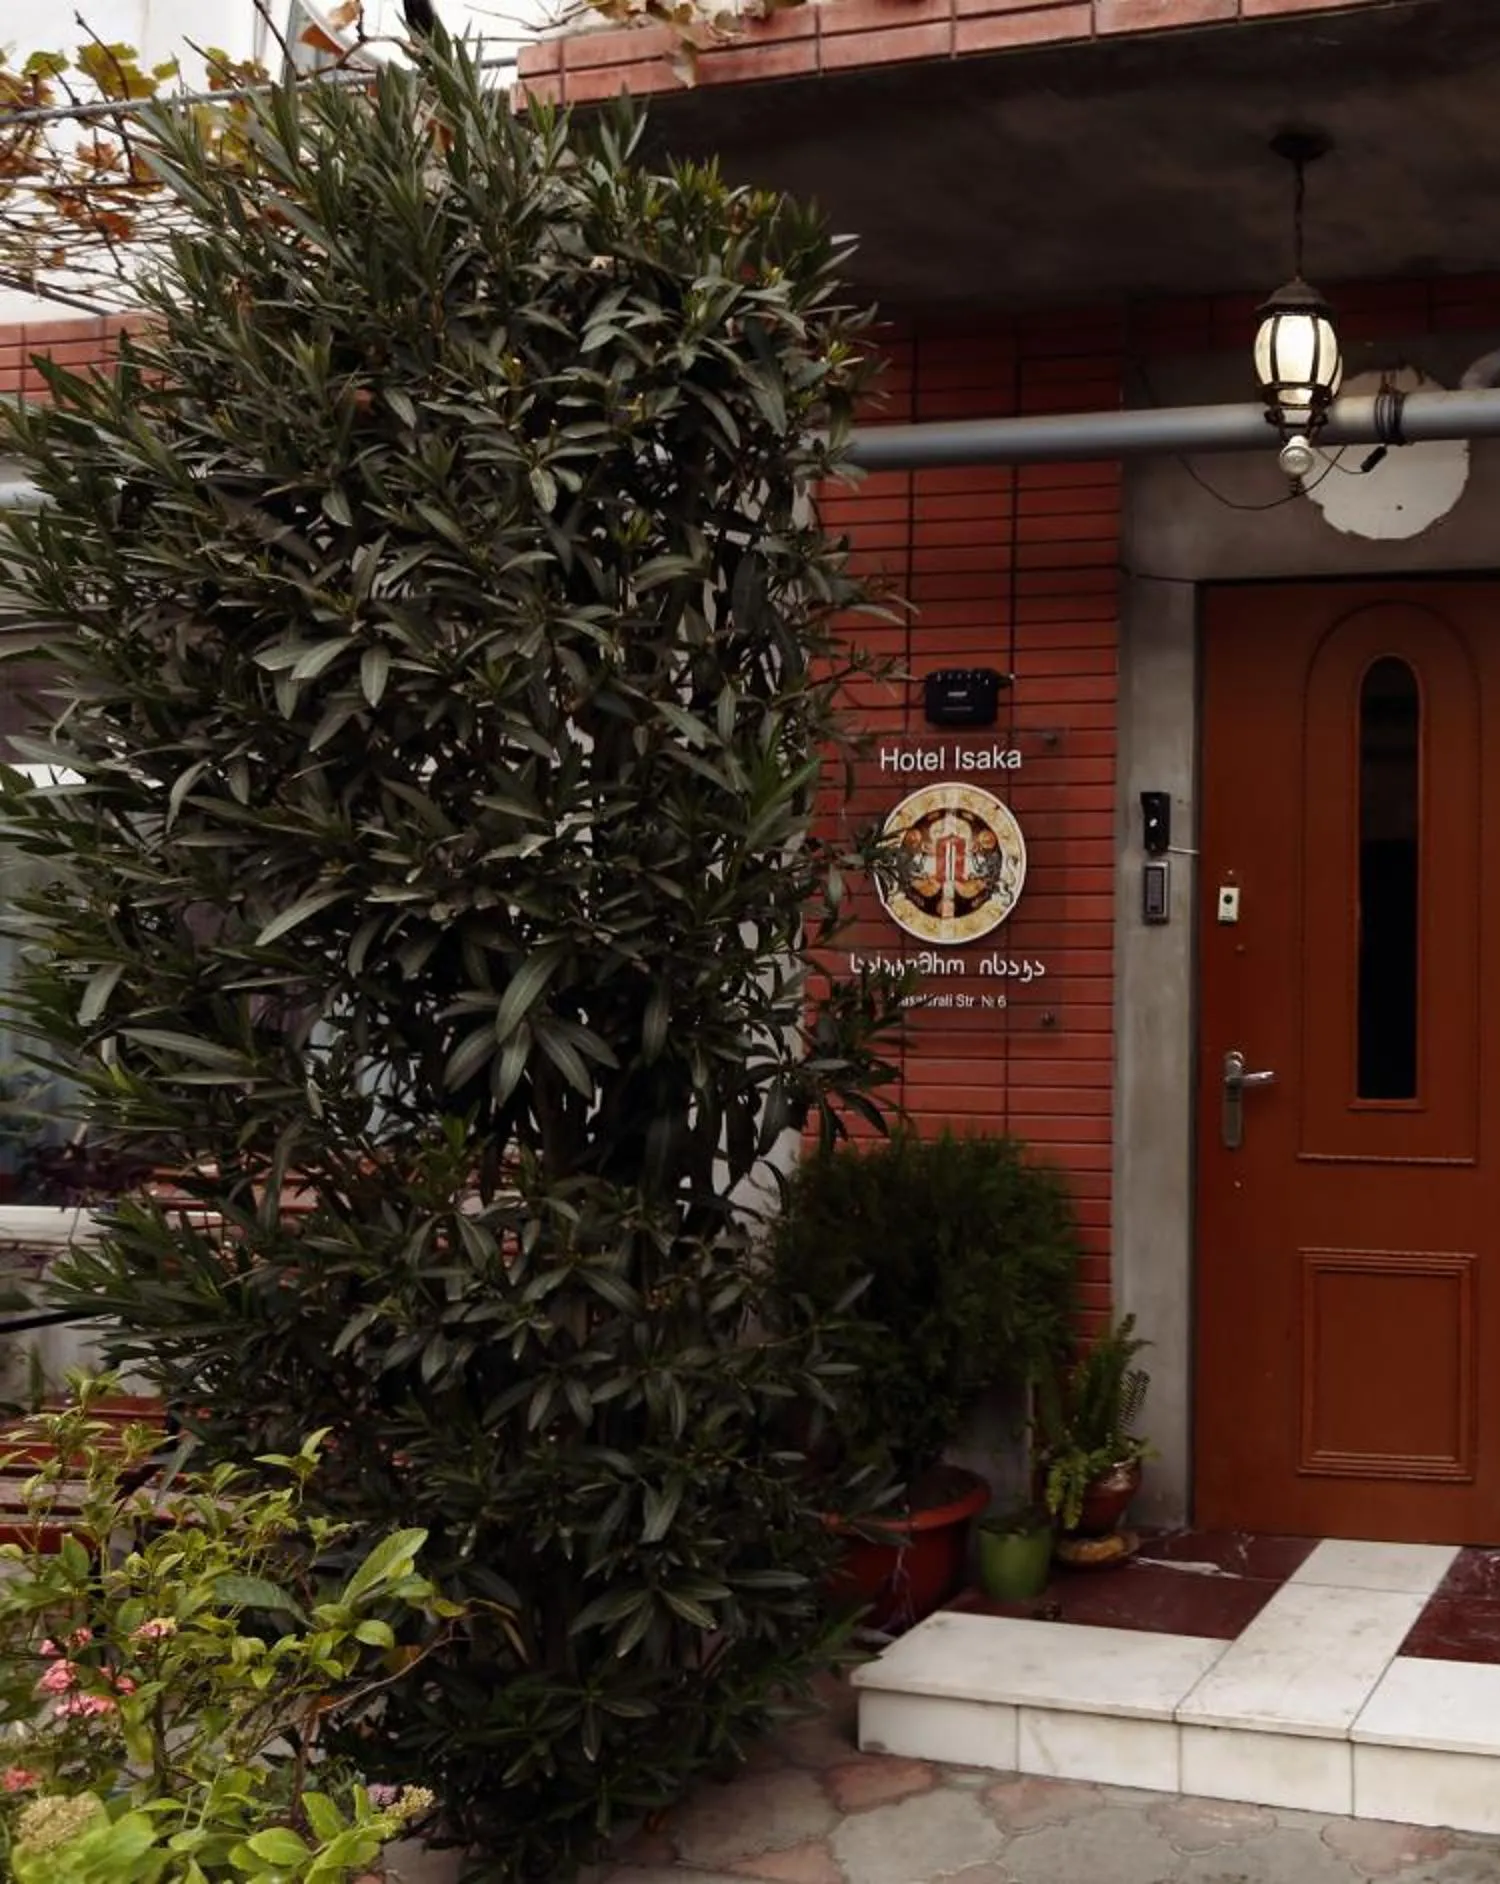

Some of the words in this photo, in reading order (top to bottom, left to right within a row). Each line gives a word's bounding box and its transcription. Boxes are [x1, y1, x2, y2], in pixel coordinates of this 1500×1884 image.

[881, 747, 945, 772] Hotel
[954, 745, 1022, 770] Isaka
[979, 952, 1046, 982] ისაკა
